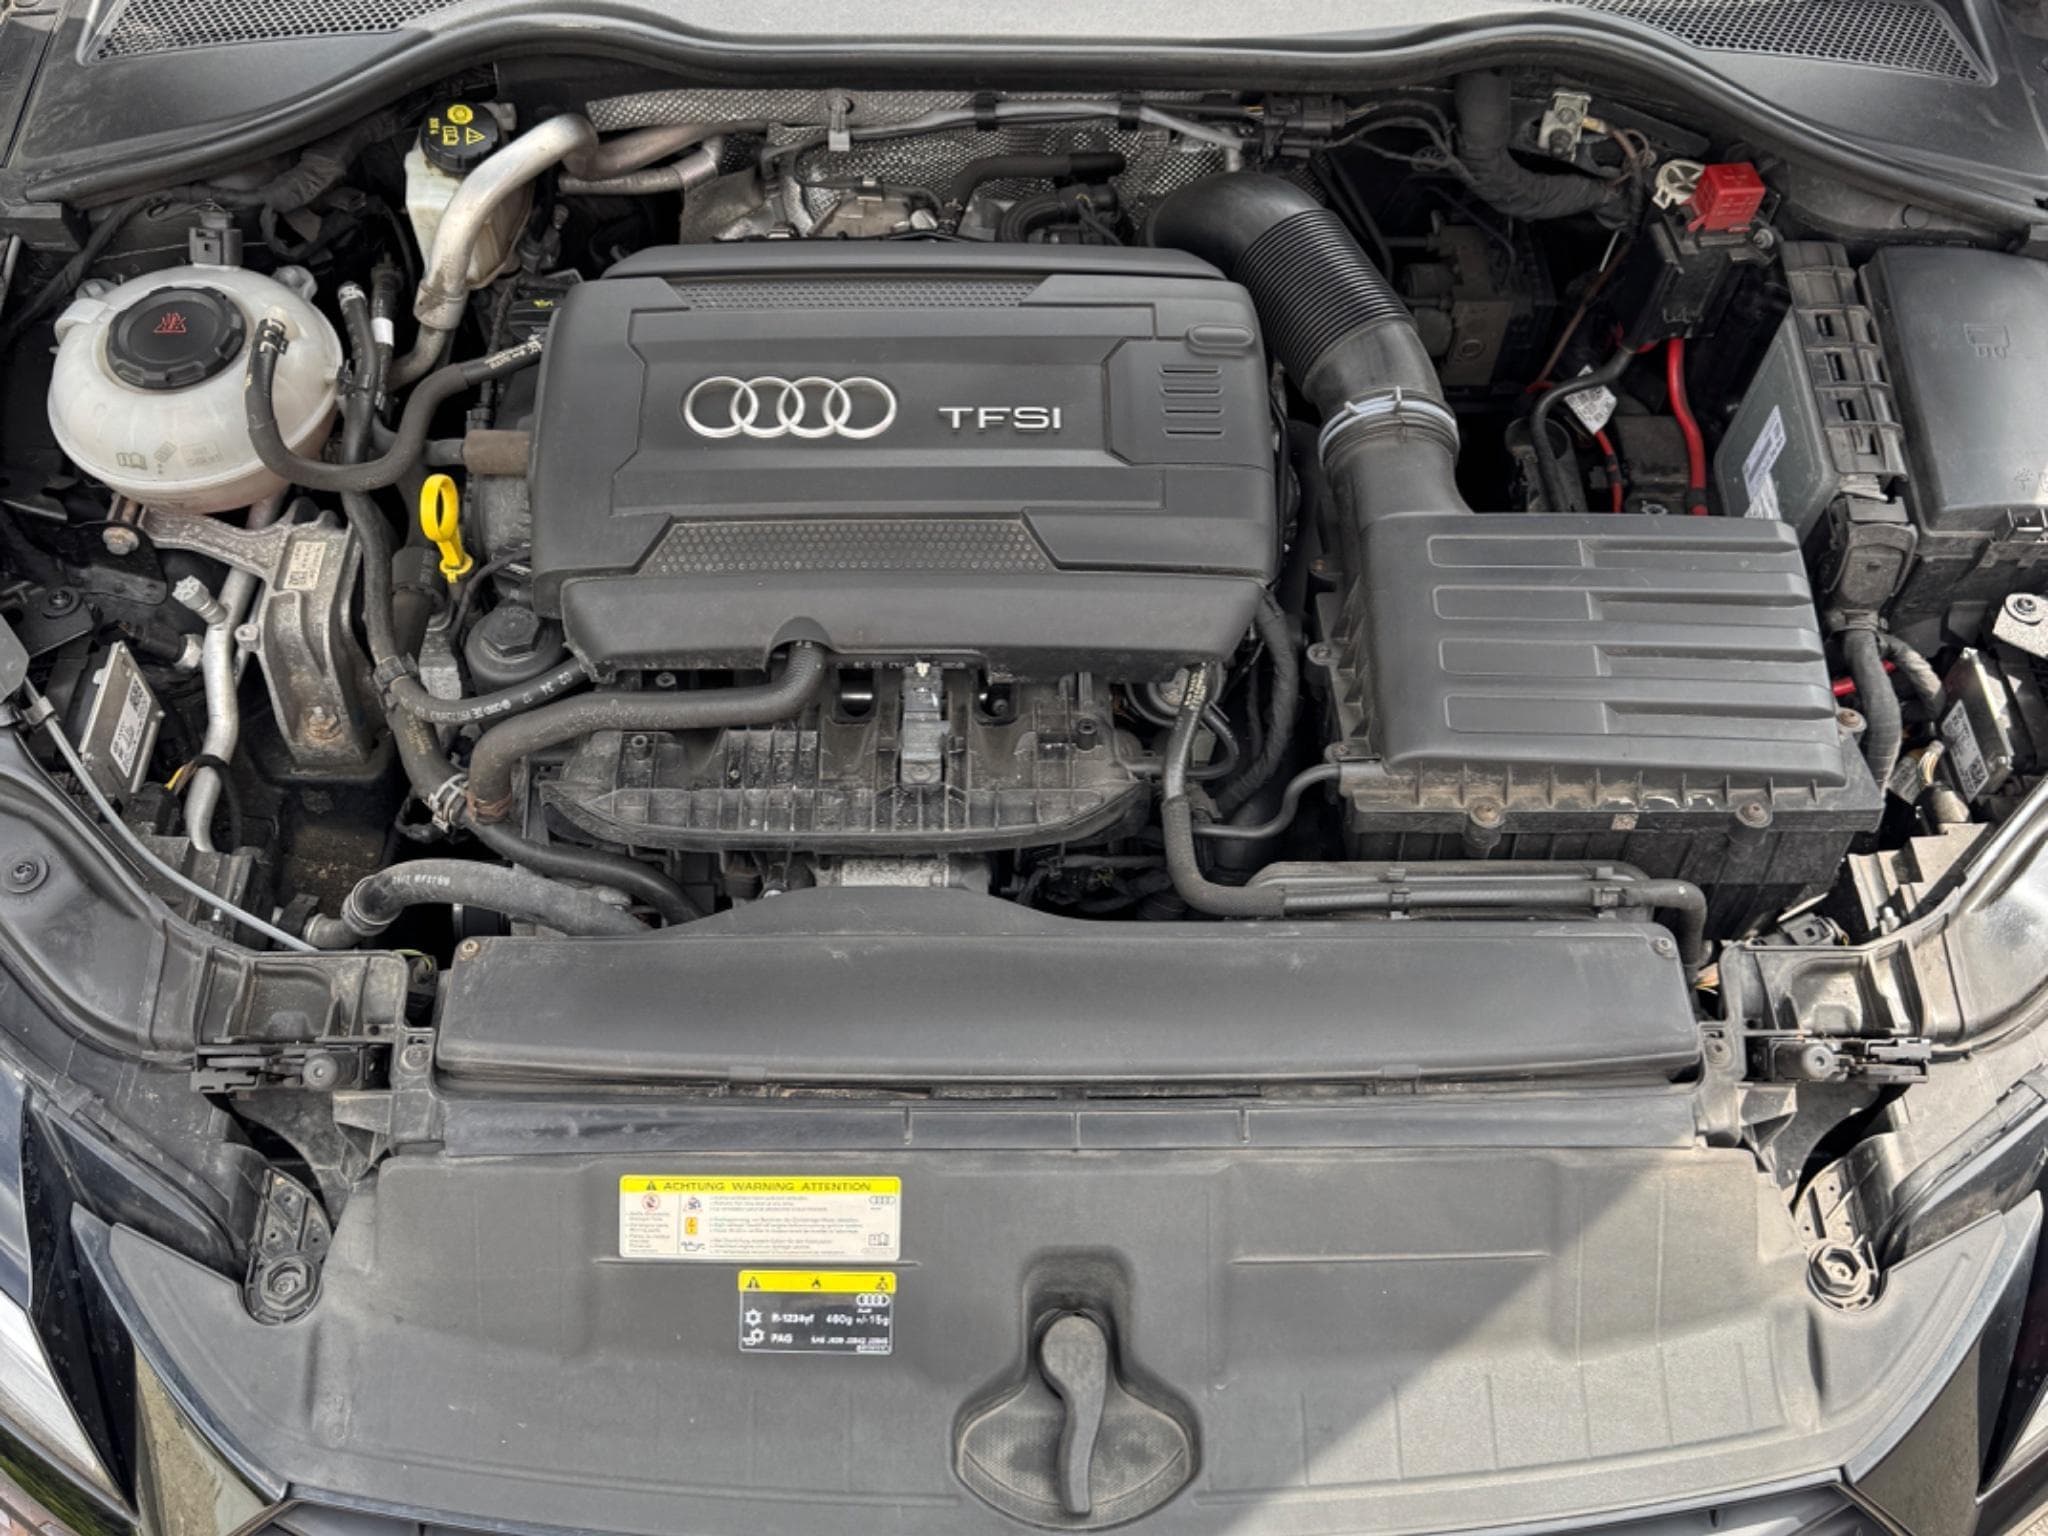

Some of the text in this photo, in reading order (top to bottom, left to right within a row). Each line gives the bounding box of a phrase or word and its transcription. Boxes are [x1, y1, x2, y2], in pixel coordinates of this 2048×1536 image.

[939, 407, 1061, 429] TFSI
[663, 1182, 871, 1191] ACHTUNG WARNING ATTENTION
